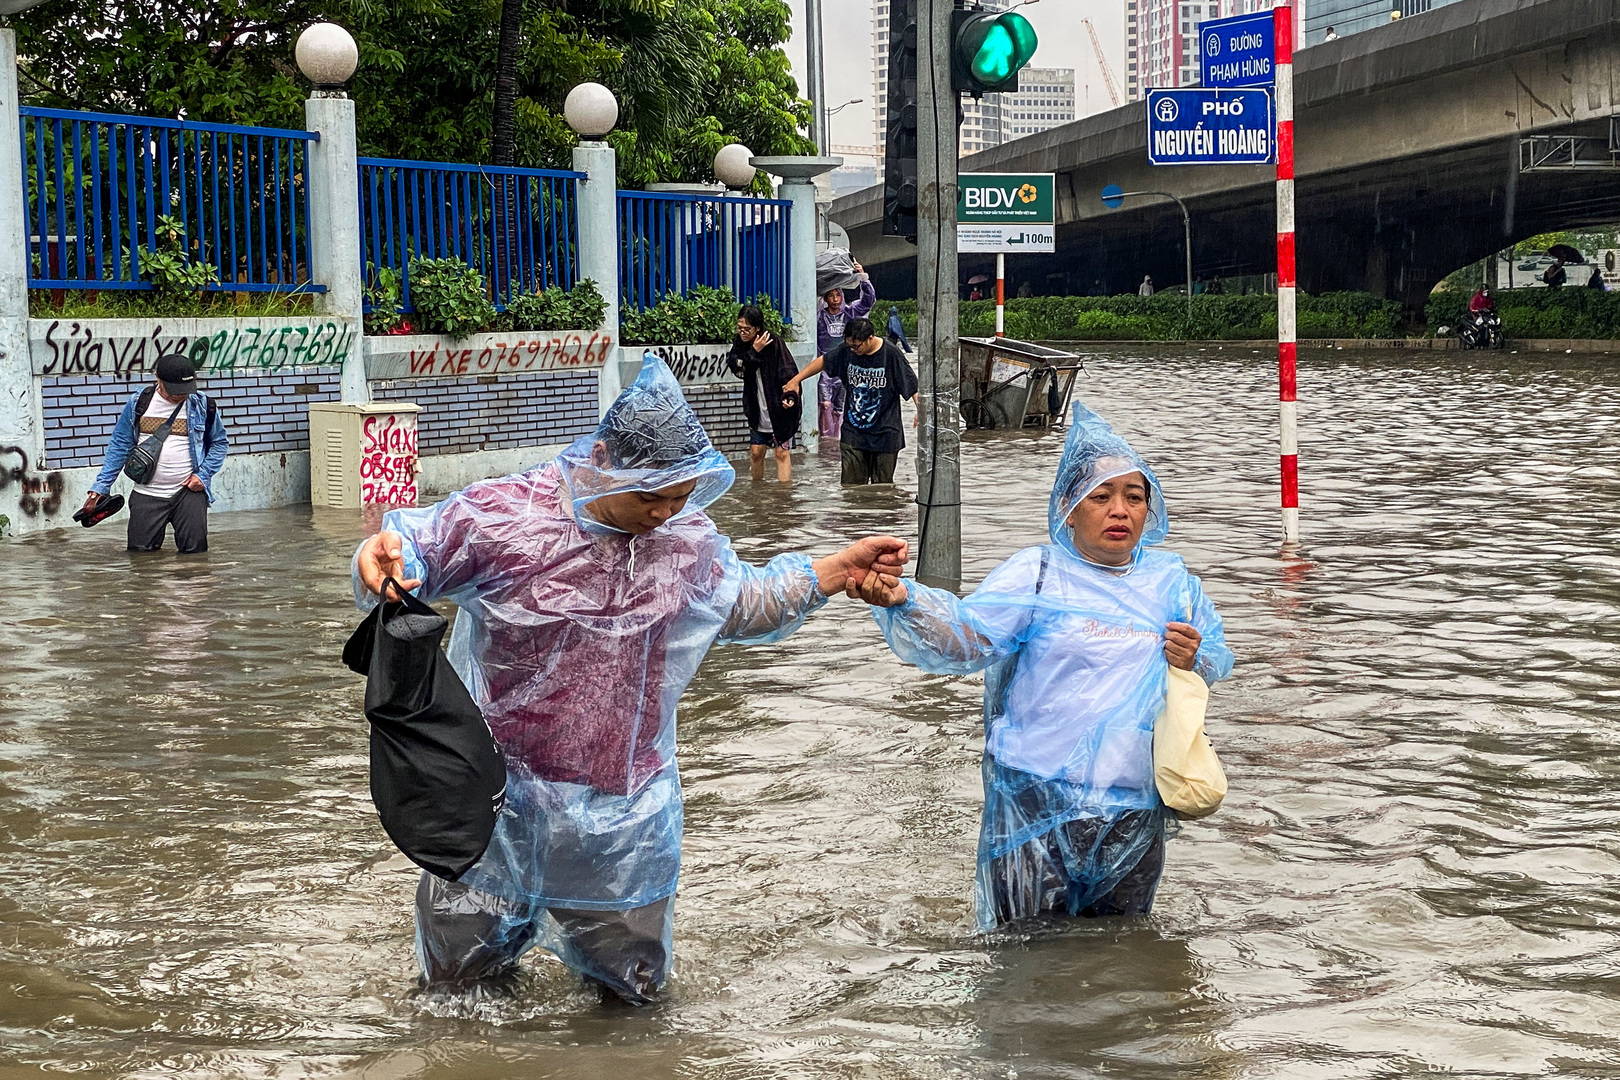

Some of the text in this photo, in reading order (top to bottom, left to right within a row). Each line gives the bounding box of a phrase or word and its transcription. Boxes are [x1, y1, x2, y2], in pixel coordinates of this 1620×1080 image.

[1230, 31, 1263, 52] ĐƯỜNG
[1210, 56, 1270, 83] PHẠM HÙNG
[1202, 96, 1245, 116] PHỐ
[1154, 121, 1267, 156] NGUYỄN HOÀNG
[965, 187, 1019, 208] BIDV
[1025, 233, 1053, 244] 100m
[43, 321, 103, 378] Sửa
[188, 322, 350, 377] 0947657634
[410, 341, 440, 375] VÁ
[440, 348, 473, 374] XE
[477, 332, 611, 373] 0769176268
